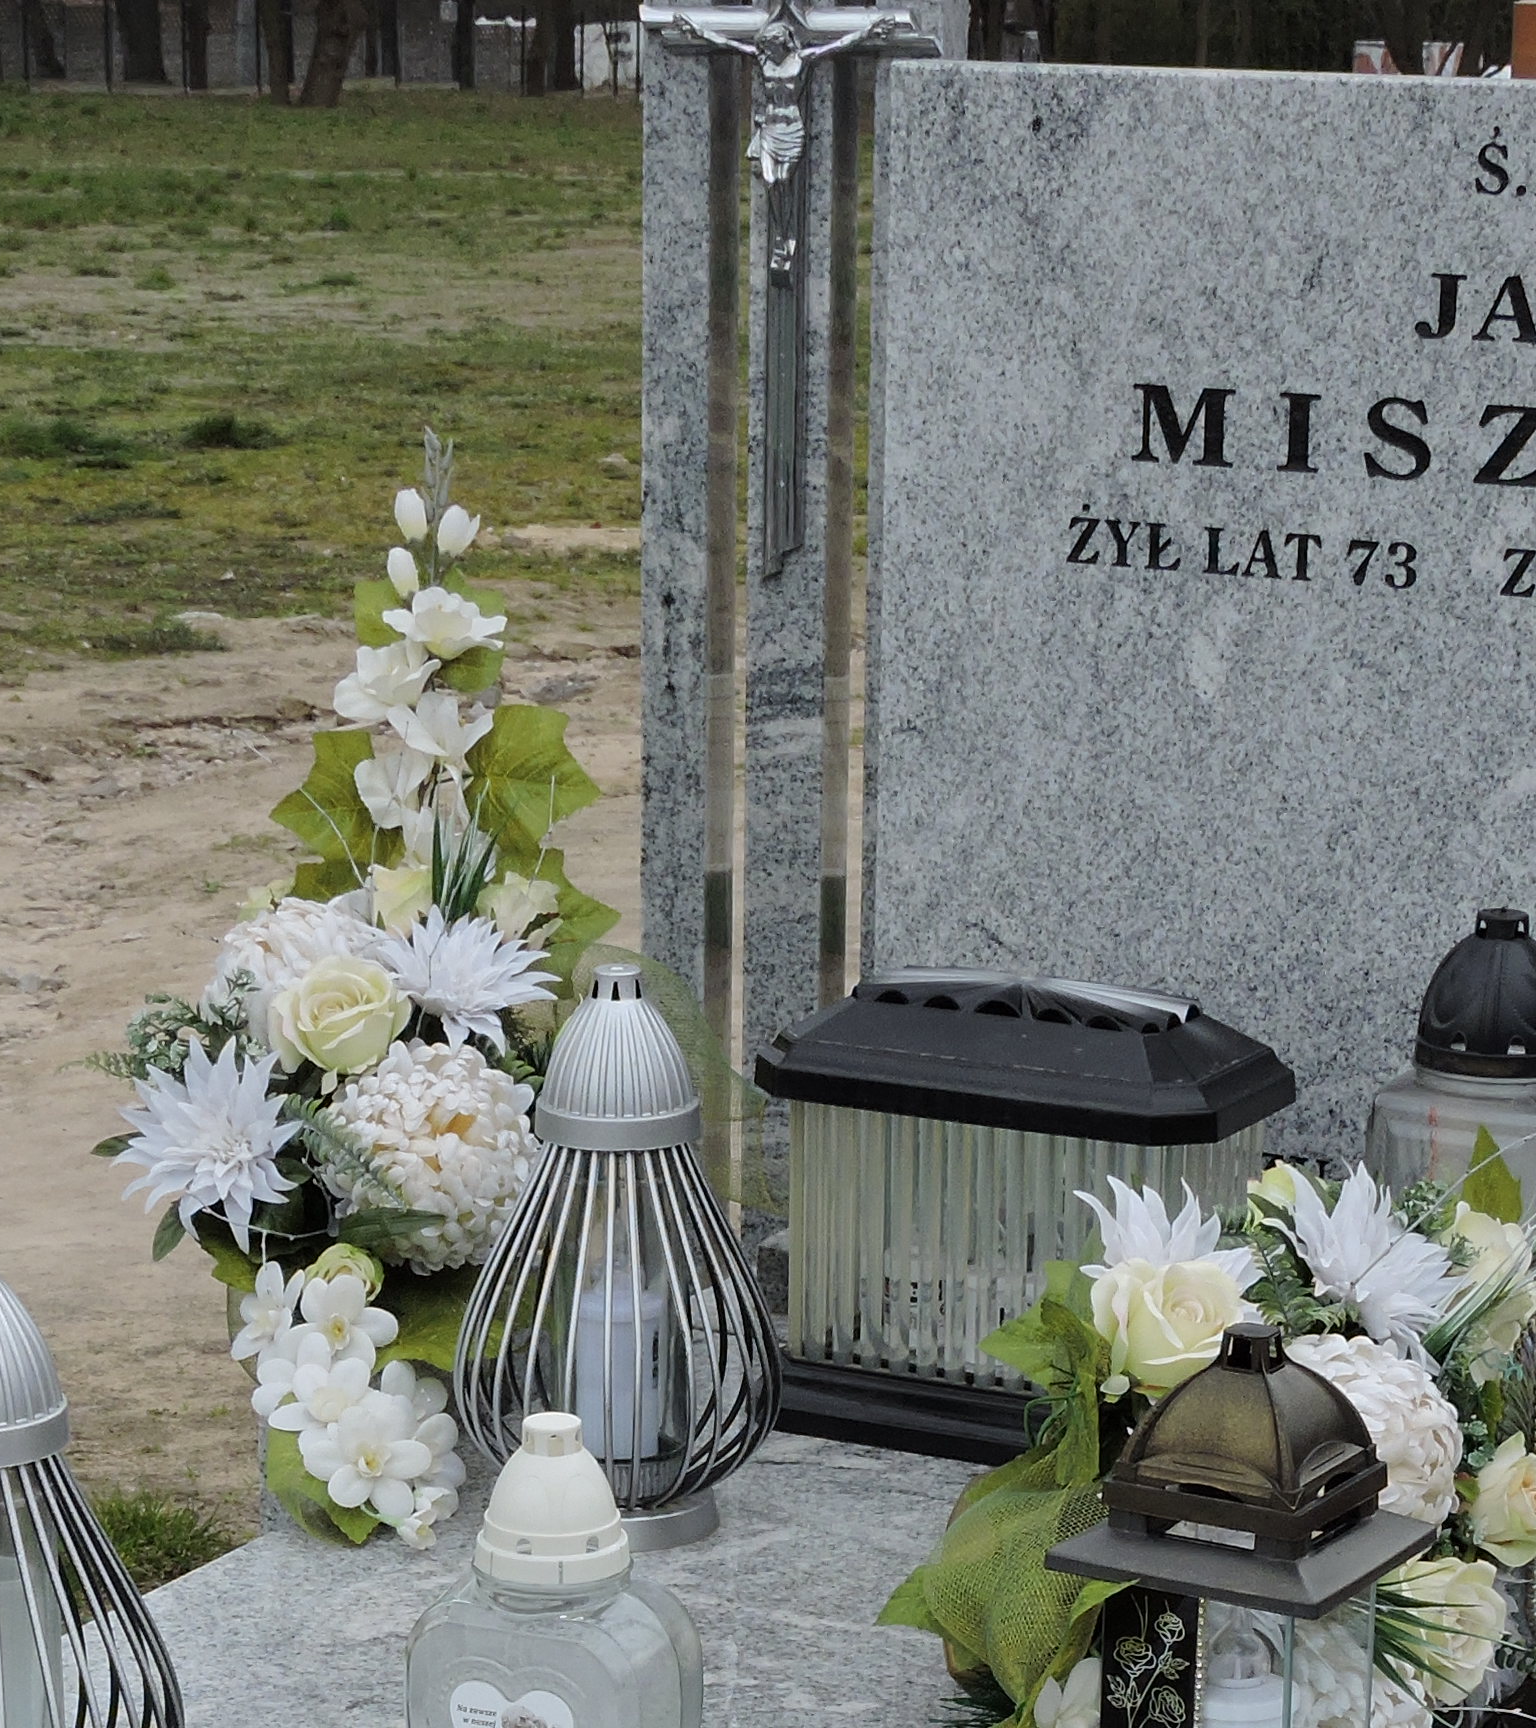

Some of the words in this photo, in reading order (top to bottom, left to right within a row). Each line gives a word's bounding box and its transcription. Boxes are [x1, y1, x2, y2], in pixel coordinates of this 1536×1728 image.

[1065, 502, 1183, 572] ŻYŁ
[1201, 525, 1323, 583] LAT
[1345, 537, 1419, 591] 73
